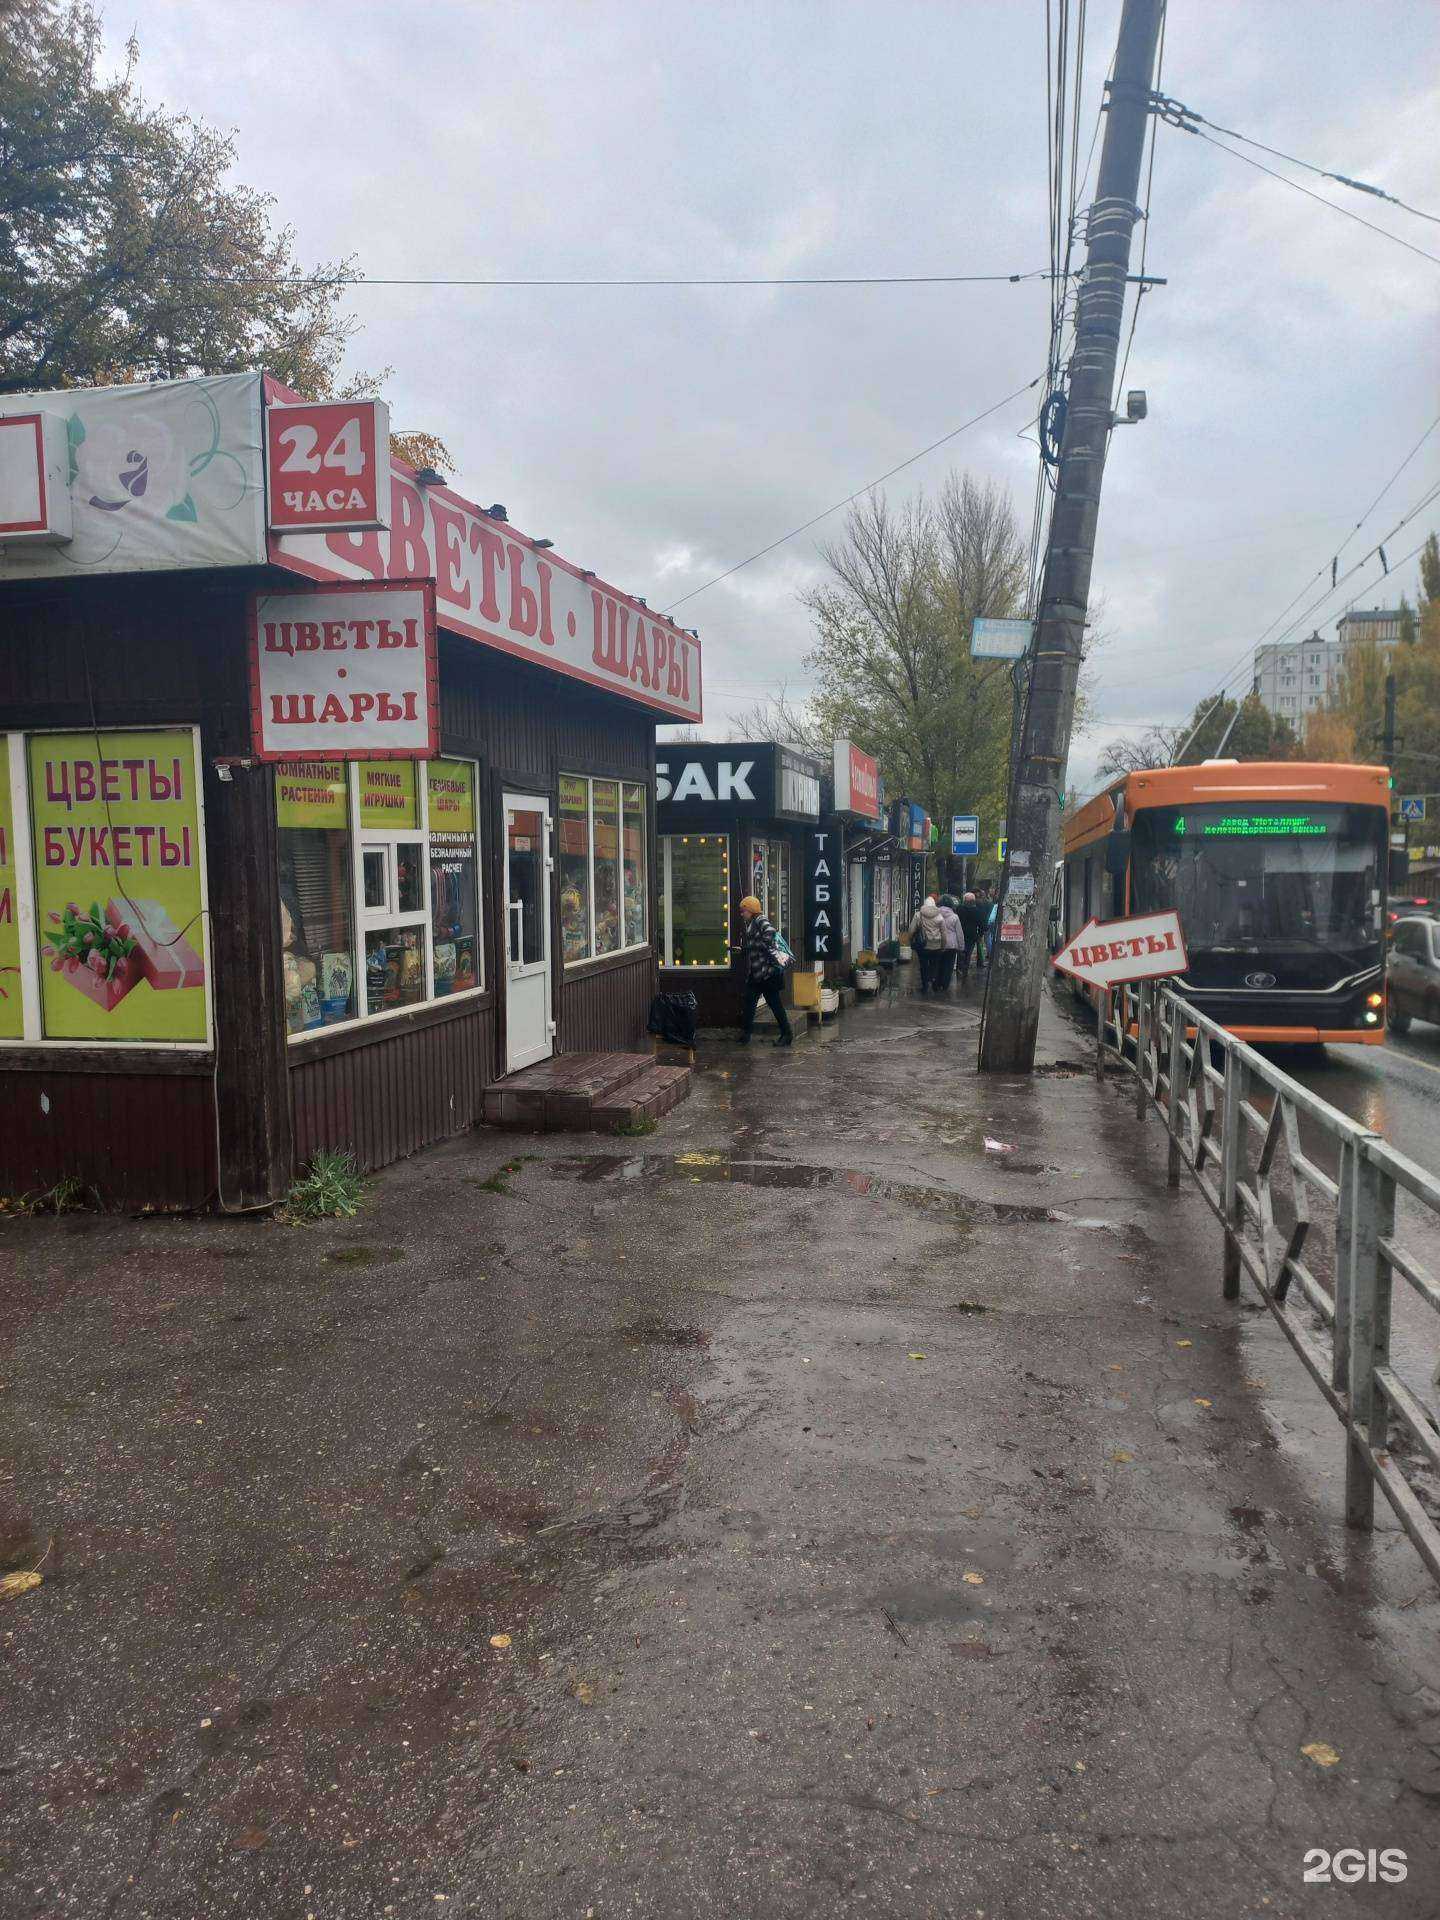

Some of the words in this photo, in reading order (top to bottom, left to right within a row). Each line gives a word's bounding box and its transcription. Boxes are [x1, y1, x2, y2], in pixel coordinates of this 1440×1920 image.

[278, 417, 366, 477] 24
[282, 487, 368, 513] ЧАСА
[263, 618, 419, 657] ЦВЕТЫ
[590, 589, 691, 703] ШАРЫ
[269, 692, 418, 724] ШАРЫ
[45, 759, 183, 811] ЦВЕТЫ
[280, 785, 336, 804] РАСТЕНИЯ
[366, 771, 401, 788] МЯГКИЕ
[364, 792, 405, 809] ИГРУШКИ
[1175, 816, 1186, 835] 4
[43, 826, 192, 867] БУКЕТЫ
[430, 845, 472, 859] БЕЗНАЛИЧНЫЙ
[814, 833, 831, 953] ТАБАК
[1069, 931, 1177, 968] ЦВЕТЫ
